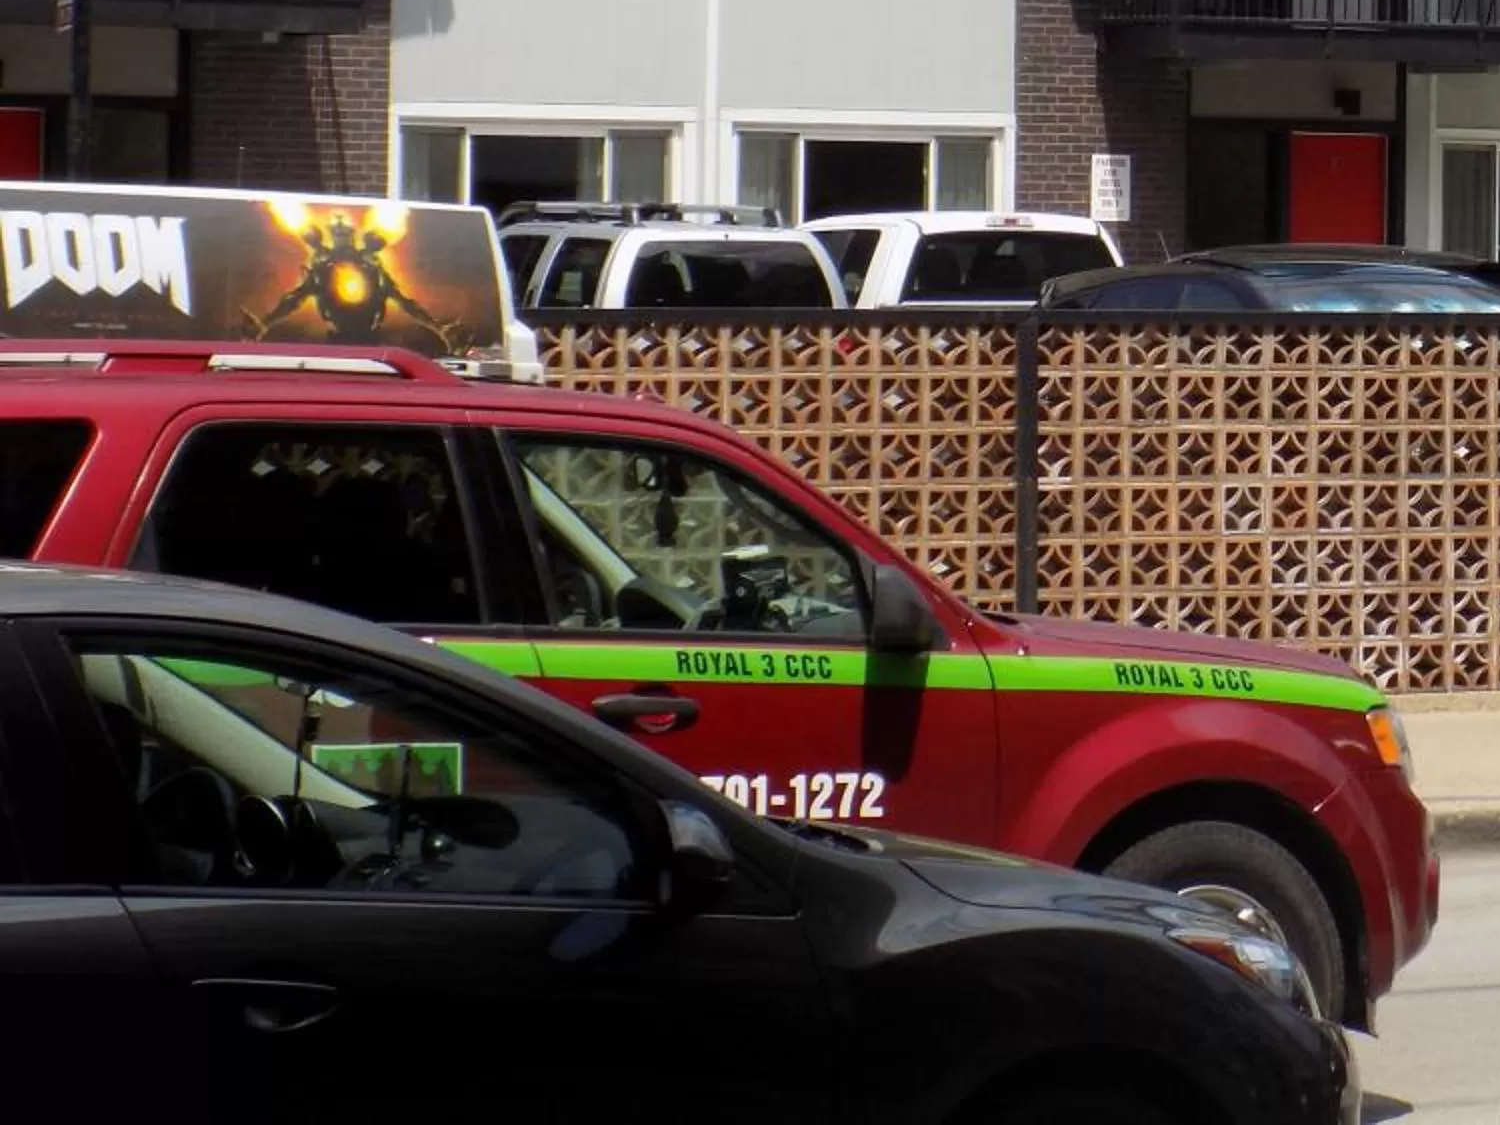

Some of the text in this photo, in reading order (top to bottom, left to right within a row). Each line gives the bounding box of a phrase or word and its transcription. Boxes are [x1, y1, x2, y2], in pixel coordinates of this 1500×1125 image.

[0, 210, 192, 316] DOOM
[676, 651, 832, 679] ROYAL 3 CCC
[1115, 662, 1255, 692] ROYAL 3 CCC
